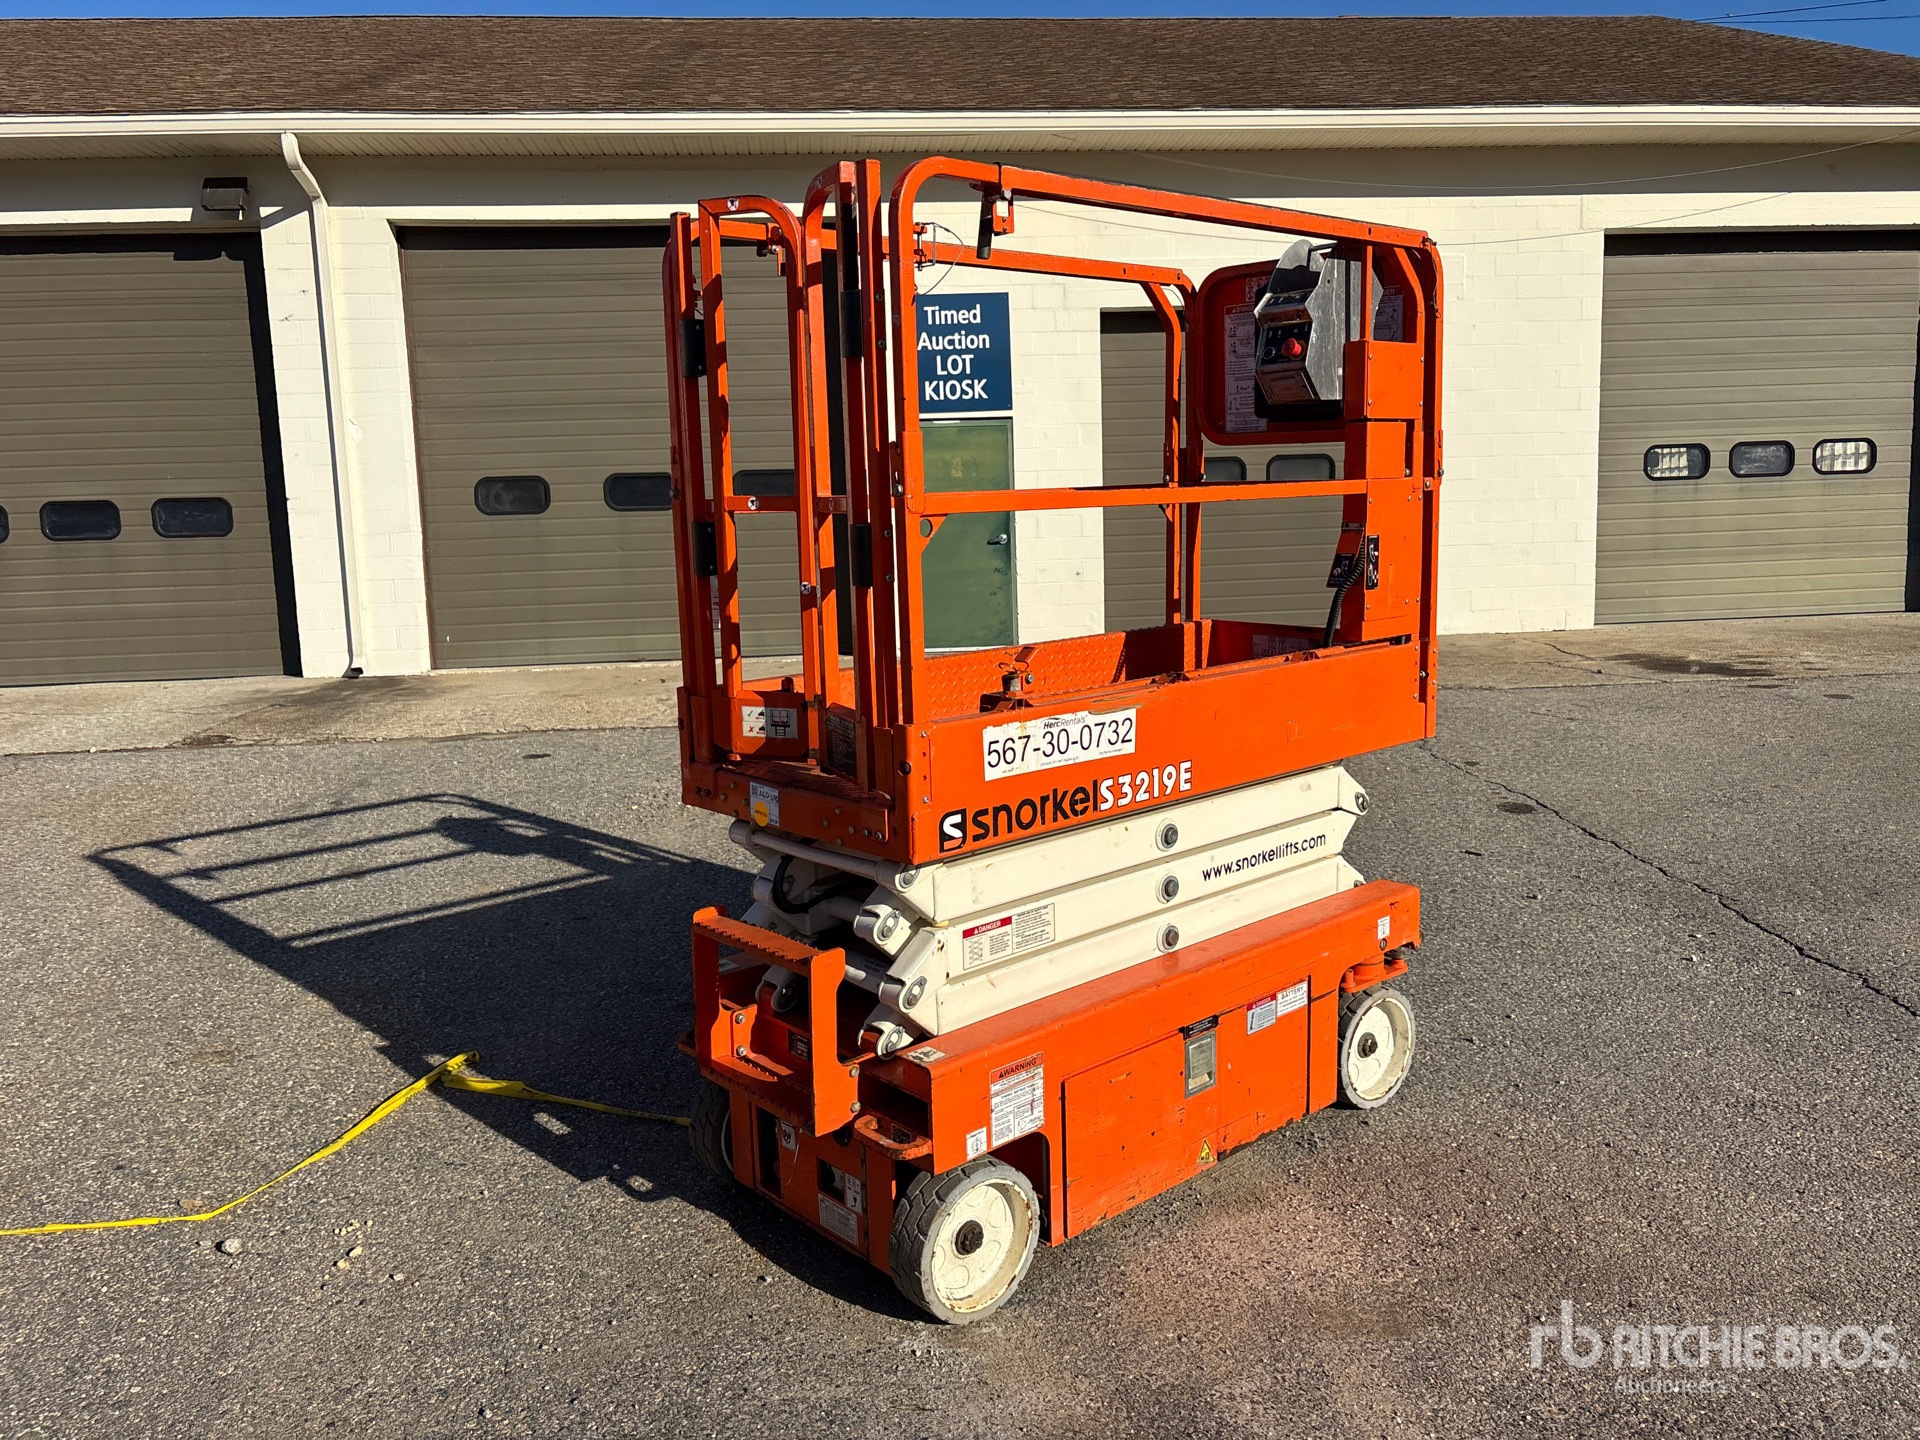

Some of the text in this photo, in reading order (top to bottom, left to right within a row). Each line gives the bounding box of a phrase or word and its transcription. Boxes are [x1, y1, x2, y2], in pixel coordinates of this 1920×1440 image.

[923, 303, 981, 326] Timed
[916, 329, 991, 351] Auction
[936, 354, 975, 376] LOT
[924, 378, 989, 401] KIOSK
[986, 717, 1134, 769] 567-30-0732
[971, 778, 1099, 843] snorkel
[1099, 760, 1193, 813] S3219E
[1201, 833, 1327, 882] www.snorkellifts.com
[979, 920, 1002, 932] DANGER
[1281, 985, 1304, 1000] BATTERY
[1002, 1057, 1037, 1077] WARNING
